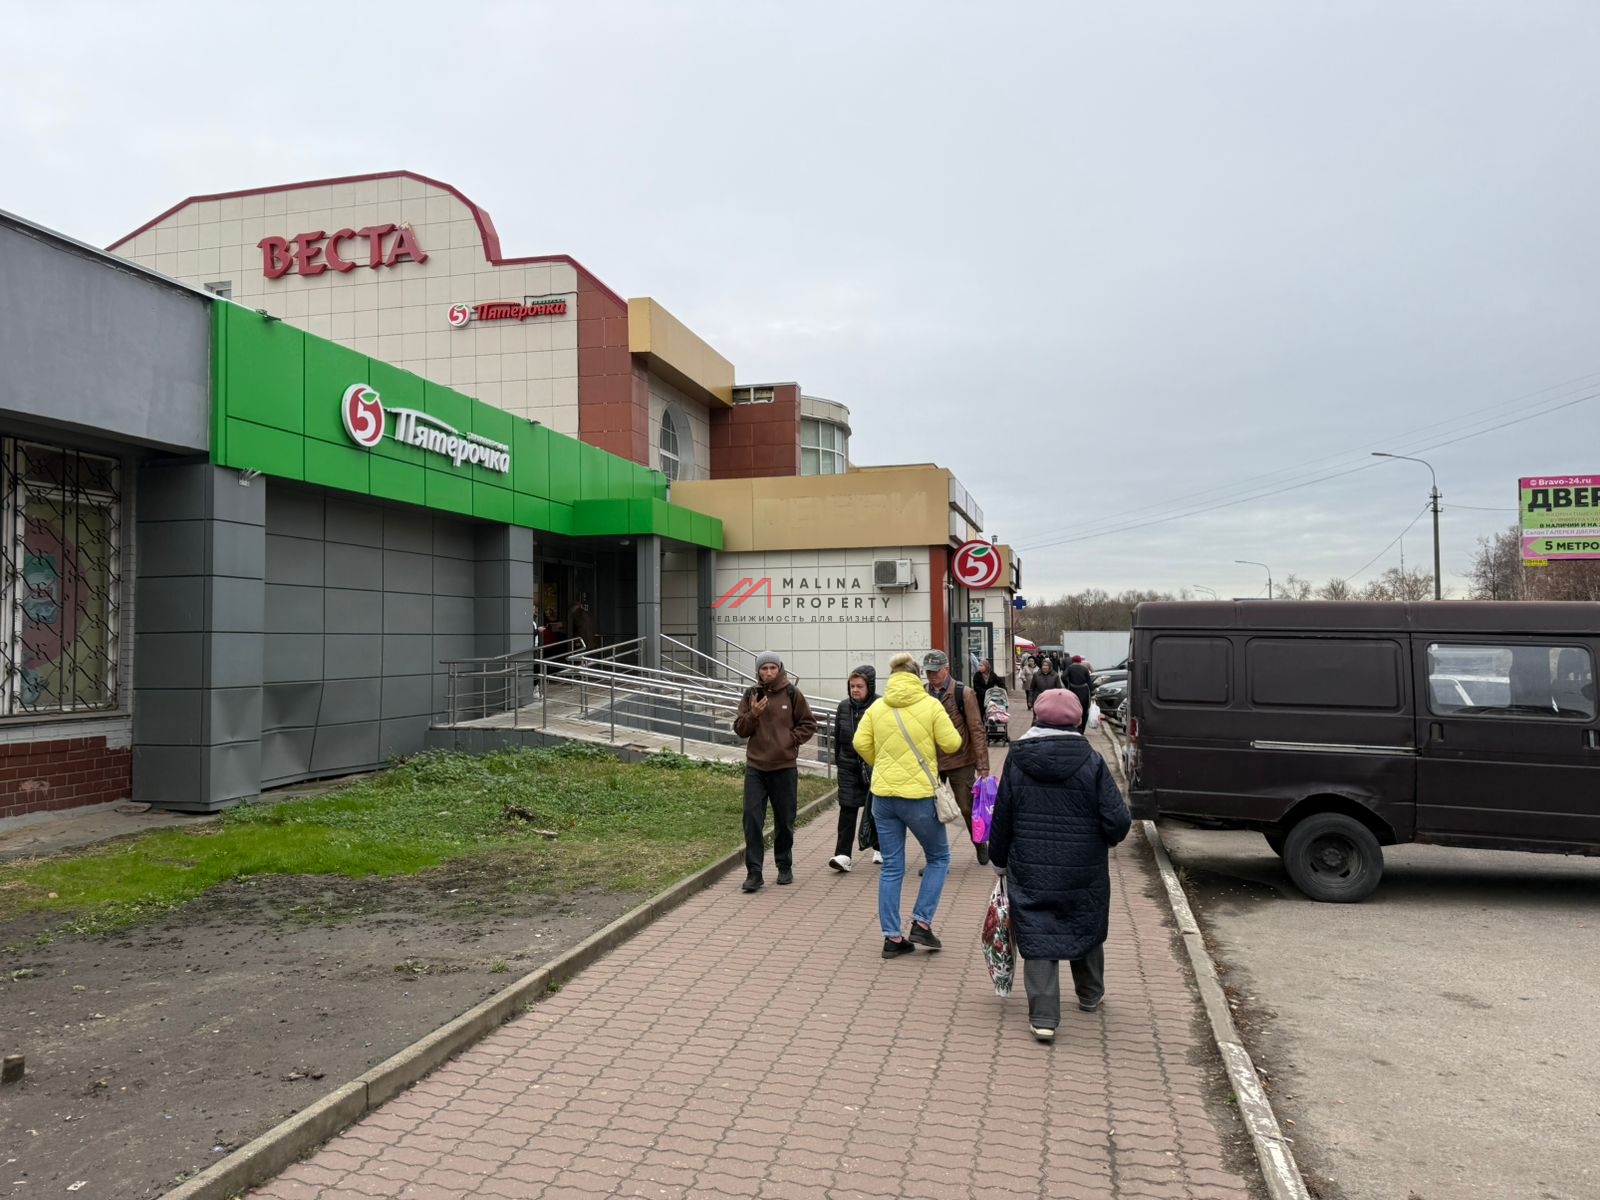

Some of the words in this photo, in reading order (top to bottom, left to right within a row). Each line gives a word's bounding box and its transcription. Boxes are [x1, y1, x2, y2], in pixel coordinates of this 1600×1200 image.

[257, 220, 429, 280] ВЕСТА
[473, 301, 567, 322] Пятерочка
[387, 406, 511, 475] Пятерочка
[1538, 477, 1592, 486] Bravo-24.ru
[1545, 541, 1553, 550] 5
